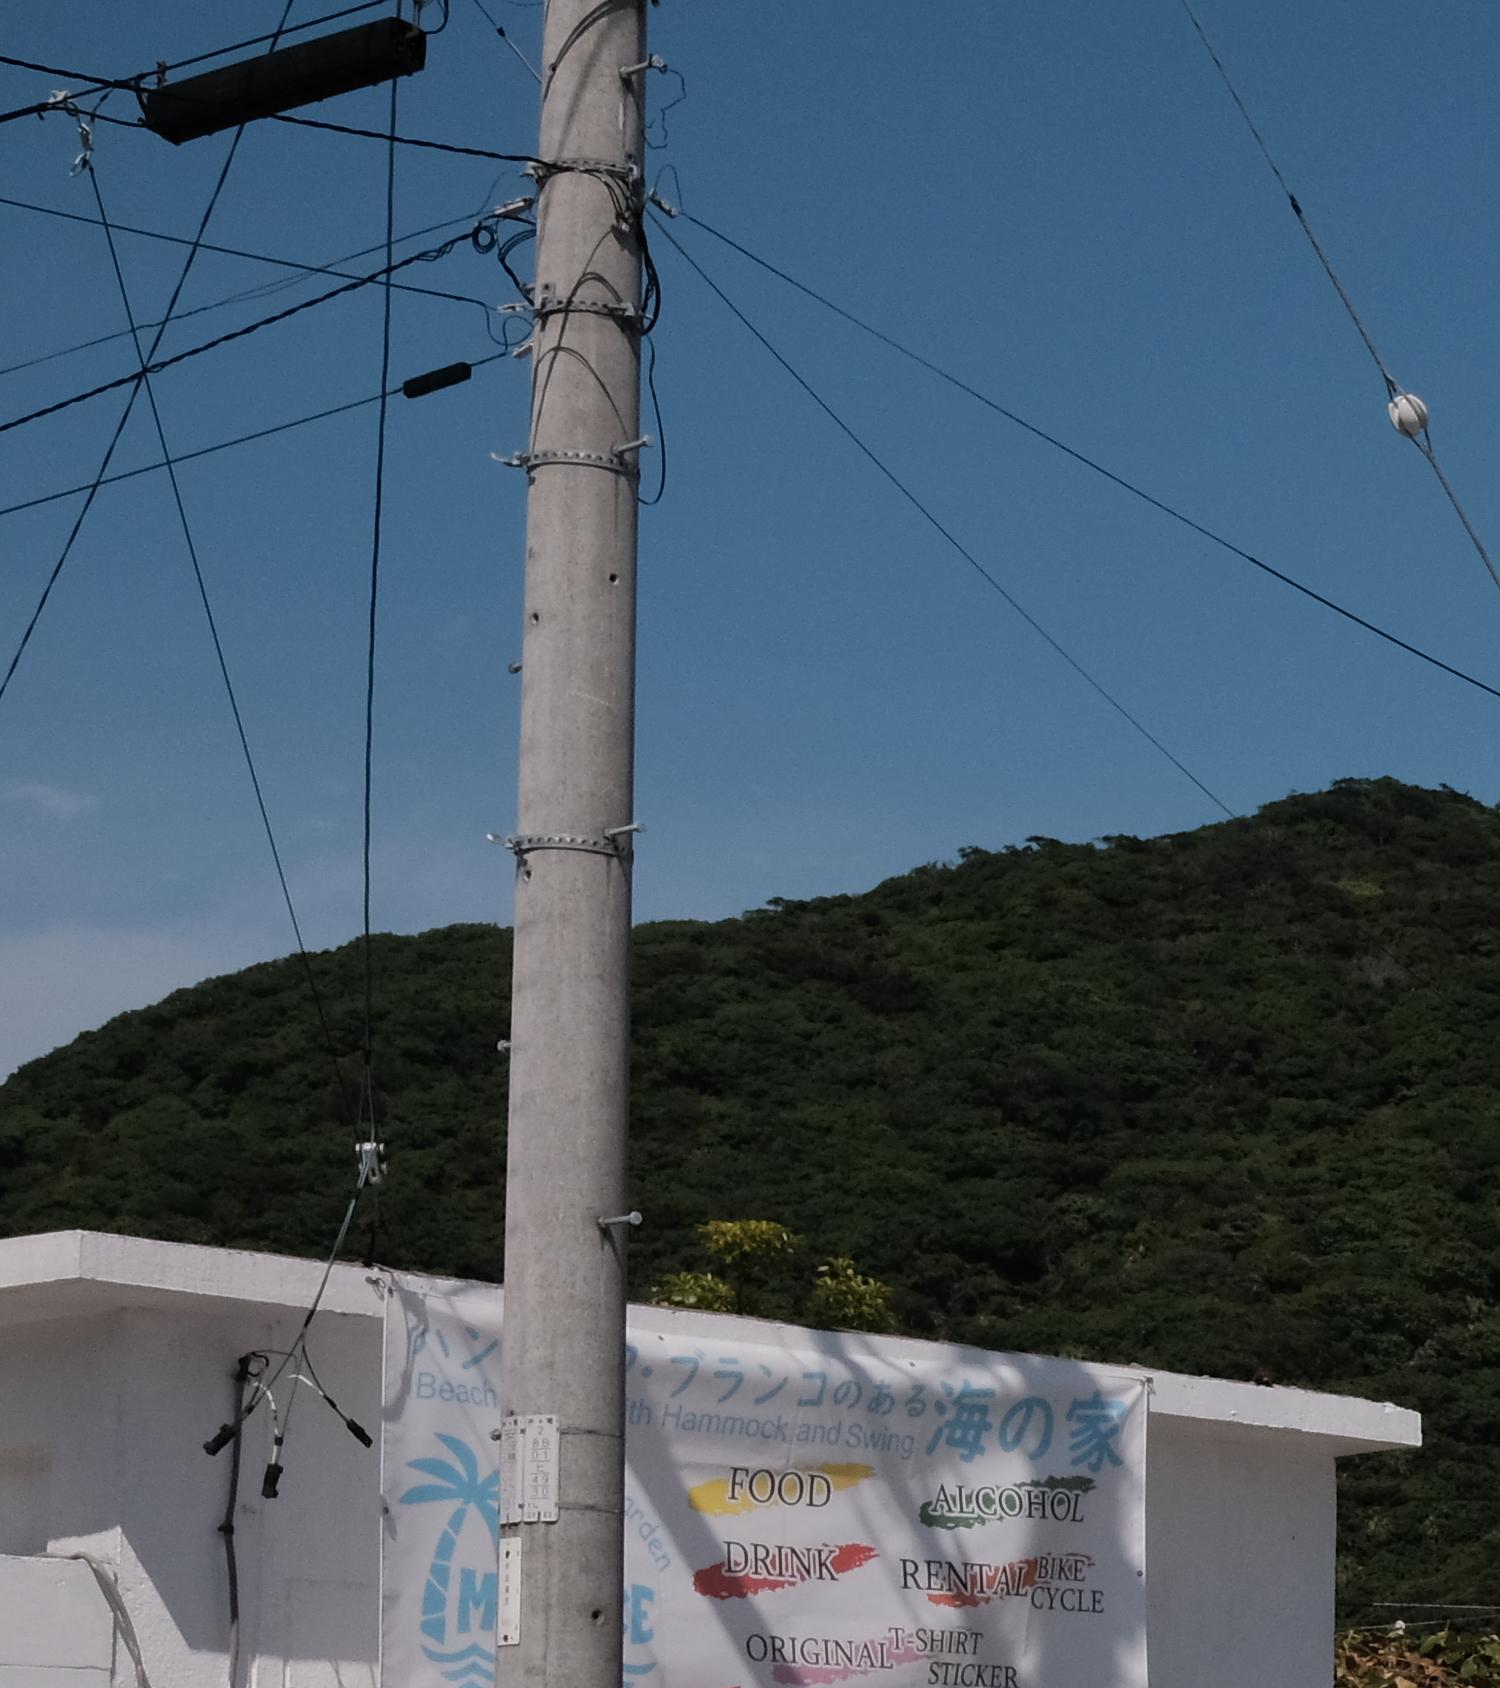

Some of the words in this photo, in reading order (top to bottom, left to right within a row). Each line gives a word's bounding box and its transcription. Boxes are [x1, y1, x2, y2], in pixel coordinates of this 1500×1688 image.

[416, 1371, 498, 1407] Beach
[661, 1402, 786, 1441] Hammock
[798, 1420, 843, 1448] and
[846, 1424, 915, 1460] Swing
[727, 1466, 833, 1510] FOOD
[931, 1482, 1086, 1525] ALCOHOL
[724, 1539, 839, 1583] DRINK
[900, 1556, 1034, 1600] RENTAL
[1036, 1553, 1088, 1583] BIKE
[1031, 1584, 1106, 1615] CYCLE
[745, 1632, 896, 1671] ORIGINAL
[889, 1626, 984, 1657] T-SHIRT
